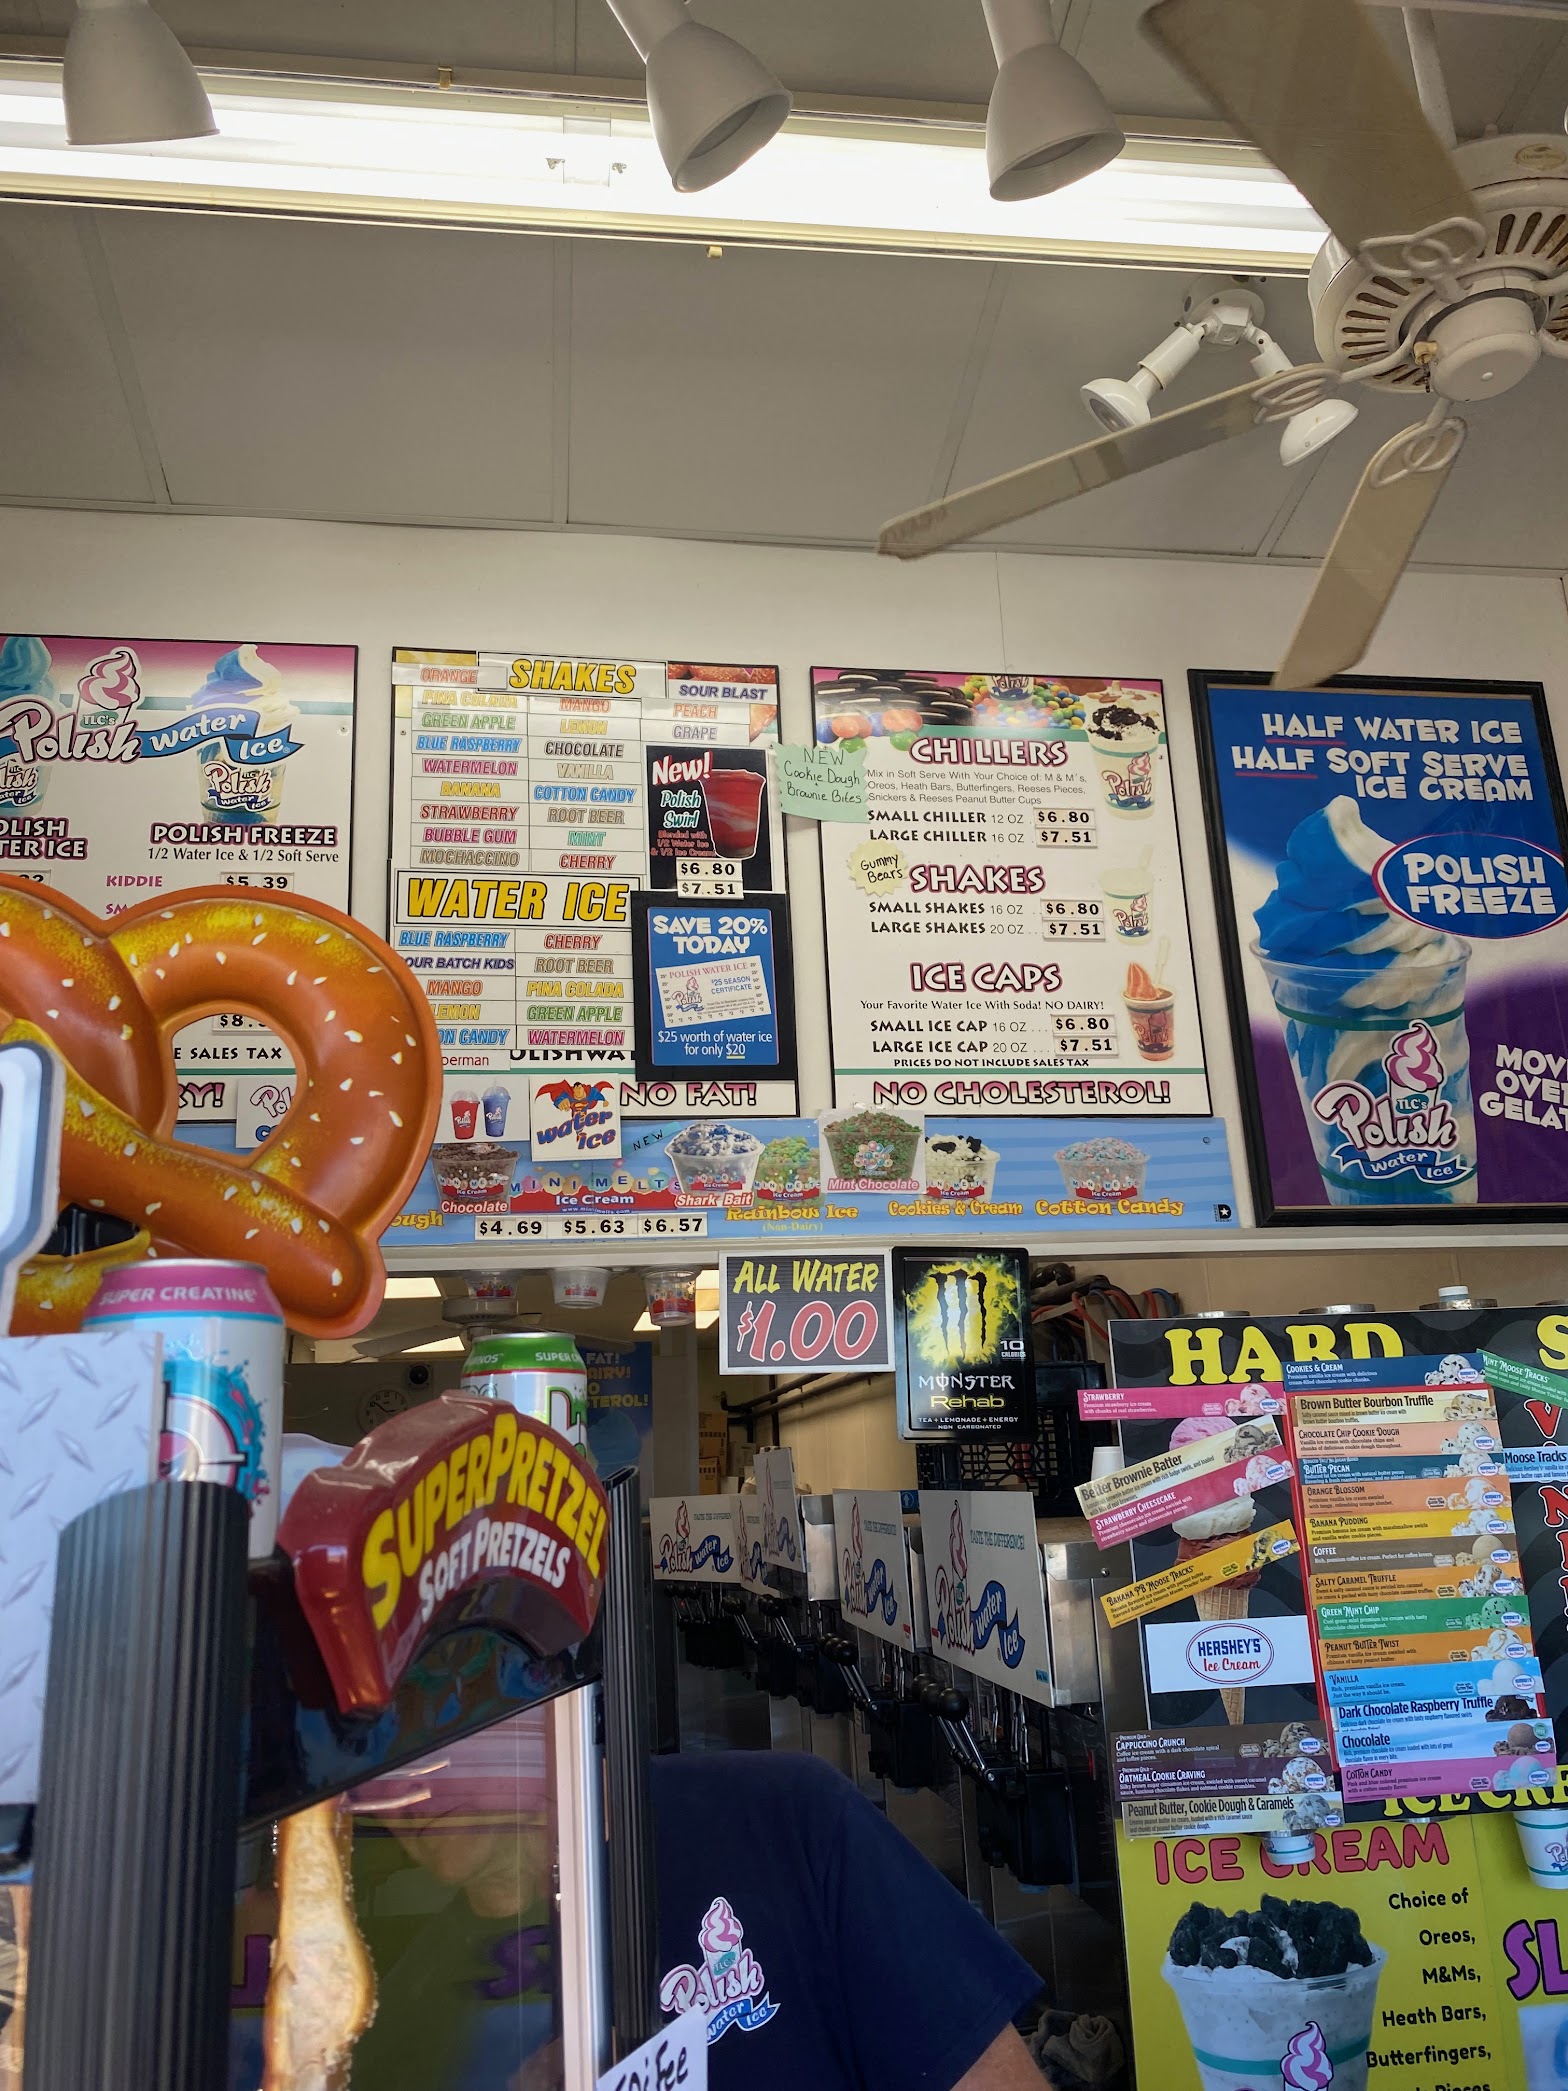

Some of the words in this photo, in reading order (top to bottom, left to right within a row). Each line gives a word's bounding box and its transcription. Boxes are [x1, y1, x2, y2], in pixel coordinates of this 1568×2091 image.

[509, 659, 636, 694] SHAKES
[679, 685, 718, 698] SOUR
[722, 687, 768, 700] BLAST
[0, 701, 141, 762] Polish
[150, 711, 247, 752] water
[239, 737, 284, 759] Ice
[1262, 714, 1344, 738] HALF
[1355, 717, 1459, 744] WATER
[1471, 721, 1523, 744] ICE
[803, 748, 844, 765] NEW
[910, 738, 1069, 767] CHILLERS
[1232, 746, 1314, 771] HALF
[1326, 749, 1409, 775] SOFT
[1422, 752, 1529, 777] SERVE
[423, 759, 518, 775] WATERMELON
[652, 751, 712, 785] New!
[784, 759, 823, 781] Cookie
[826, 768, 860, 786] Dough
[787, 781, 828, 800] Brownie
[832, 787, 862, 803] Bites
[1356, 776, 1407, 799] ICE
[1419, 778, 1533, 802] CREAM
[868, 792, 907, 803] Snickers
[910, 793, 916, 803] &
[919, 793, 952, 803] Reeses
[955, 794, 988, 804] Peanut
[991, 794, 1016, 805] Butter
[1019, 795, 1042, 806] Cups
[867, 810, 919, 822] SMALL
[924, 810, 987, 823] CHILLER
[991, 814, 1003, 824] 12
[1008, 814, 1024, 824] OZ
[1037, 810, 1089, 823] $6.80
[153, 826, 242, 843] POLISH
[251, 828, 335, 844] FREEZE
[148, 848, 169, 861] 1/2
[173, 848, 211, 861] Water
[216, 849, 234, 861] Ice
[238, 850, 248, 861] &
[252, 850, 273, 862] 1/2
[278, 849, 302, 862] Soft
[306, 851, 338, 862] Serve
[860, 854, 899, 872] Gummy
[681, 863, 735, 875] $6.80
[867, 867, 903, 883] Bears
[1403, 853, 1546, 884] POLISH
[106, 876, 162, 887] KIDDIE
[226, 875, 288, 889] $5.39
[910, 863, 1045, 894] SHAKES
[408, 878, 547, 918] WATER
[563, 882, 629, 921] ICE
[1406, 886, 1556, 915] FREEZE
[653, 915, 711, 935] SAVE
[718, 916, 768, 935] 20%
[400, 931, 432, 946] BLUE
[434, 932, 509, 948] RASPBERRY
[673, 936, 750, 954] TODAY
[910, 962, 967, 992] ICE
[971, 962, 1062, 992] CAPS
[527, 981, 563, 996] PINA
[566, 982, 624, 998] COLADA
[860, 1000, 884, 1011] Your
[887, 1000, 927, 1011] Favorite
[931, 1000, 962, 1011] Water
[965, 1001, 981, 1010] Ice
[985, 1000, 1010, 1010] With
[1013, 1000, 1041, 1011] Soda!
[1045, 1001, 1064, 1010] NO
[1067, 1000, 1104, 1011] DAIRY!
[658, 1031, 677, 1043] $25
[680, 1031, 711, 1042] worth
[714, 1030, 724, 1042] of
[726, 1032, 756, 1042] water
[759, 1031, 772, 1041] ice
[894, 1059, 931, 1067] PRICES
[934, 1059, 950, 1067] DO
[954, 1059, 978, 1067] NOT
[982, 1059, 1030, 1067] INCLUDE
[1033, 1059, 1063, 1067] SALES
[1066, 1058, 1089, 1067] TAX
[874, 1081, 927, 1105] NO
[935, 1080, 1170, 1105] CHOLESTEROL!
[828, 1178, 855, 1191] Mint
[858, 1178, 920, 1190] Chocolate
[676, 1195, 715, 1207] Shark
[724, 1192, 753, 1207] Bait
[888, 1201, 952, 1216] Cookies
[955, 1204, 966, 1216] &
[969, 1202, 1024, 1216] Cream
[1035, 1200, 1112, 1216] Cotton
[1118, 1199, 1184, 1216] Candy
[479, 1220, 542, 1235] $4.69
[564, 1220, 625, 1234] $5.63
[644, 1219, 703, 1233] $6.57
[733, 1260, 780, 1294] ALL
[793, 1259, 879, 1293] WATER
[729, 1300, 878, 1361] $1.00
[1165, 1323, 1404, 1385] HARD
[919, 1373, 1015, 1389] MONSTER
[930, 1396, 1004, 1408] Rehab
[1083, 1393, 1124, 1402] STRAWBERRY
[1301, 1399, 1331, 1409] Brown
[1333, 1398, 1362, 1408] Butter
[1364, 1396, 1402, 1407] Bourbon
[1404, 1396, 1433, 1406] Truffle
[419, 1532, 472, 1622] SOFT
[472, 1516, 570, 1588] PRETZELS
[1198, 1638, 1261, 1657] HERSHEY'S
[1204, 1659, 1219, 1671] Ice
[1222, 1657, 1261, 1671] Cream
[1339, 1706, 1362, 1718] Dark
[1363, 1703, 1408, 1716] Chocolate
[1411, 1700, 1459, 1713] Raspberry
[1461, 1697, 1493, 1709] Truffle
[1128, 1803, 1158, 1816] Peanut
[1160, 1802, 1187, 1816] Butter,
[1189, 1801, 1217, 1813] Cookie
[1219, 1800, 1246, 1814] Dough
[1248, 1800, 1255, 1810] &
[1256, 1796, 1294, 1809] Caramels
[1388, 1891, 1447, 1910] Choice
[1451, 1887, 1469, 1904] of
[1419, 1928, 1476, 1945] Oreos,
[1422, 1965, 1481, 1985] M&Ms,
[1366, 2047, 1491, 2068] Butterfingers,
